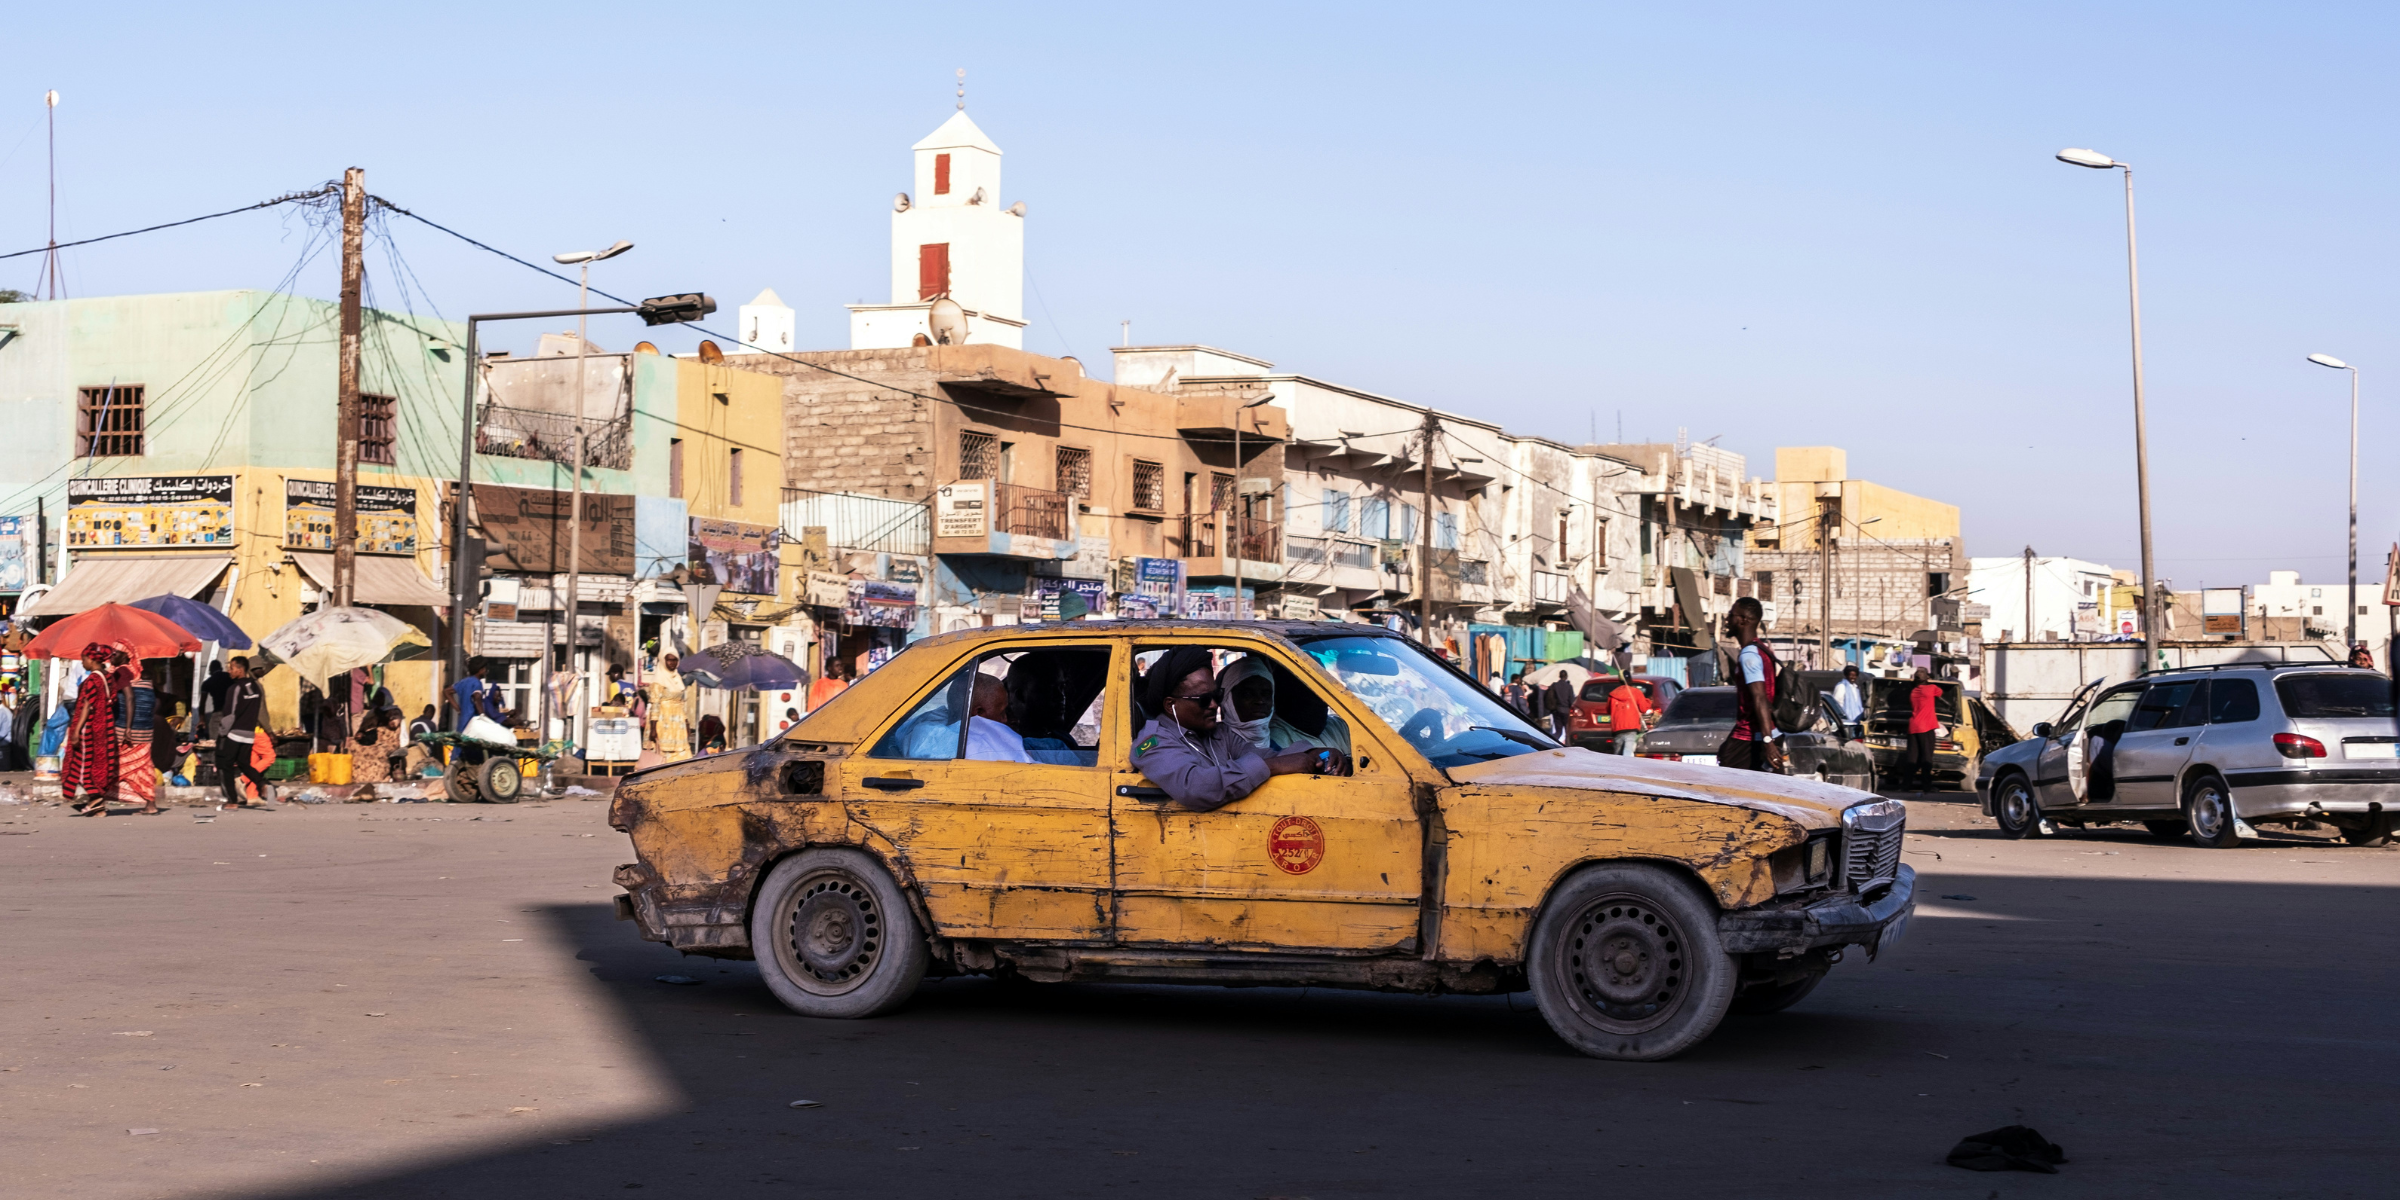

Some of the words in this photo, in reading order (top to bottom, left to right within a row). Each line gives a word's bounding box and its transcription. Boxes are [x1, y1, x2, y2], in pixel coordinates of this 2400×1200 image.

[69, 479, 119, 496] QUINCALLERIE
[119, 478, 152, 495] CLINIQUE
[196, 477, 232, 493] خردوات
[288, 480, 330, 499] QUINCALLERIE
[1076, 582, 1102, 592] متجر
[1272, 818, 1319, 838] TOUT-DROIT
